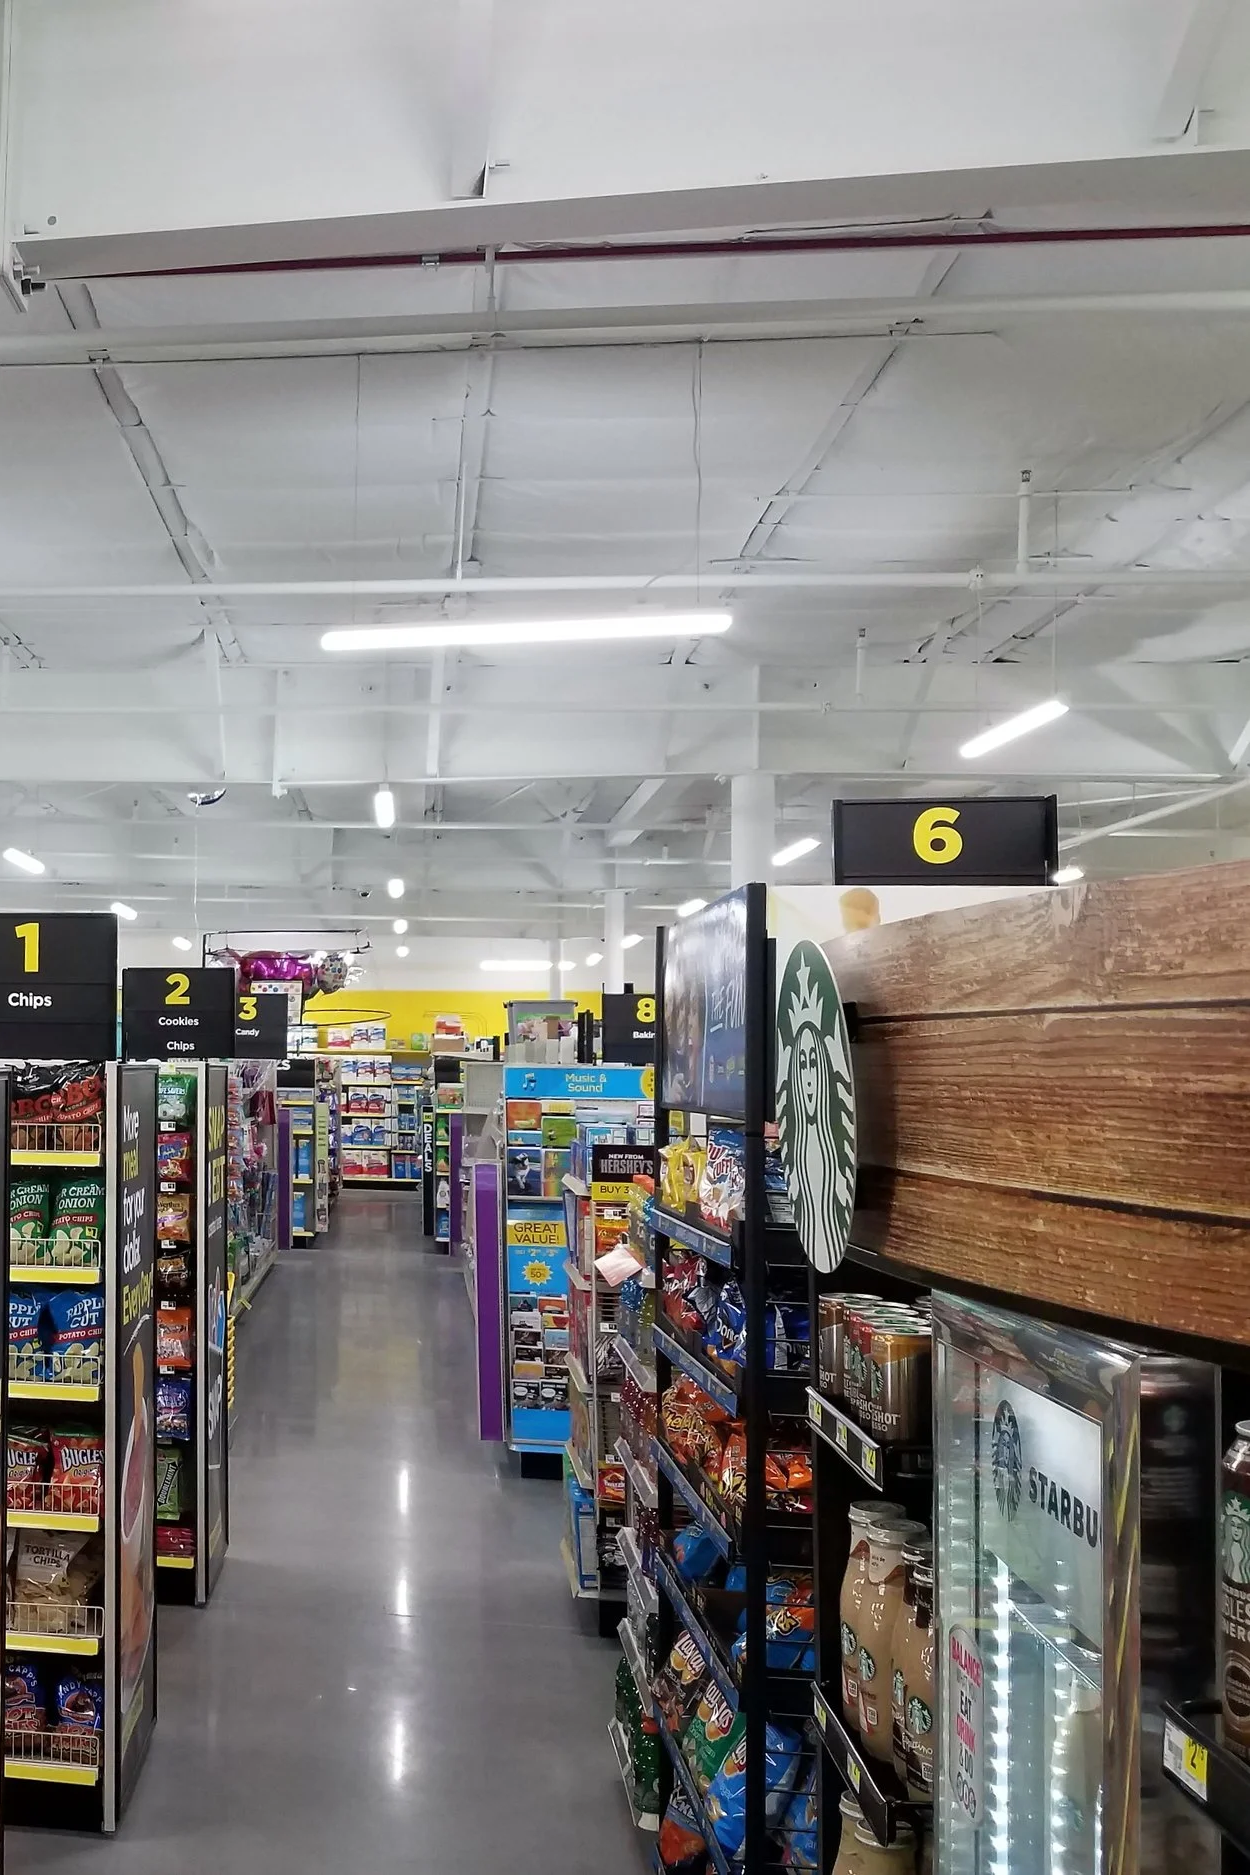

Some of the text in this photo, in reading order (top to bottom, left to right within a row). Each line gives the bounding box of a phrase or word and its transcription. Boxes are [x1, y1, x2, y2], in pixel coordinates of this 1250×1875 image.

[912, 807, 963, 864] 6
[14, 923, 39, 972] 1
[165, 973, 190, 1005] 2
[8, 992, 52, 1009] Chips
[238, 997, 257, 1020] 3
[636, 997, 655, 1023] 8
[158, 1016, 199, 1027] Cookies
[235, 1028, 260, 1037] Candy
[166, 1039, 195, 1052] Chips
[565, 1073, 607, 1083] Music &
[567, 1083, 604, 1093] Sound
[123, 1104, 139, 1143] More
[423, 1123, 434, 1172] DEALS
[122, 1139, 139, 1182] meal
[600, 1158, 654, 1175] HERSHEY'S
[16, 1183, 50, 1197] CREAM
[68, 1183, 106, 1198] CREAM
[600, 1185, 630, 1194] BUY 3
[58, 1197, 96, 1210] ONION
[123, 1187, 146, 1229] for your
[71, 1215, 94, 1224] CHIPS
[513, 1222, 559, 1234] GREAT
[514, 1234, 560, 1245] VALUE!
[123, 1283, 142, 1326] Every
[70, 1313, 99, 1328] CUT
[58, 1327, 103, 1341] POTATO CHIP
[7, 1450, 39, 1467] UGLE
[61, 1448, 104, 1471] BUGLES
[158, 1463, 178, 1504] DOUBLEMINT
[1028, 1465, 1100, 1549] STARBU
[24, 1544, 70, 1562] TORTILLA
[33, 1555, 62, 1568] CHIPS
[951, 1637, 982, 1689] BALANCE
[8, 1664, 38, 1687] CAPP'S
[960, 1690, 973, 1723] EAT
[956, 1717, 976, 1752] DRINK
[964, 1754, 974, 1780] DO
